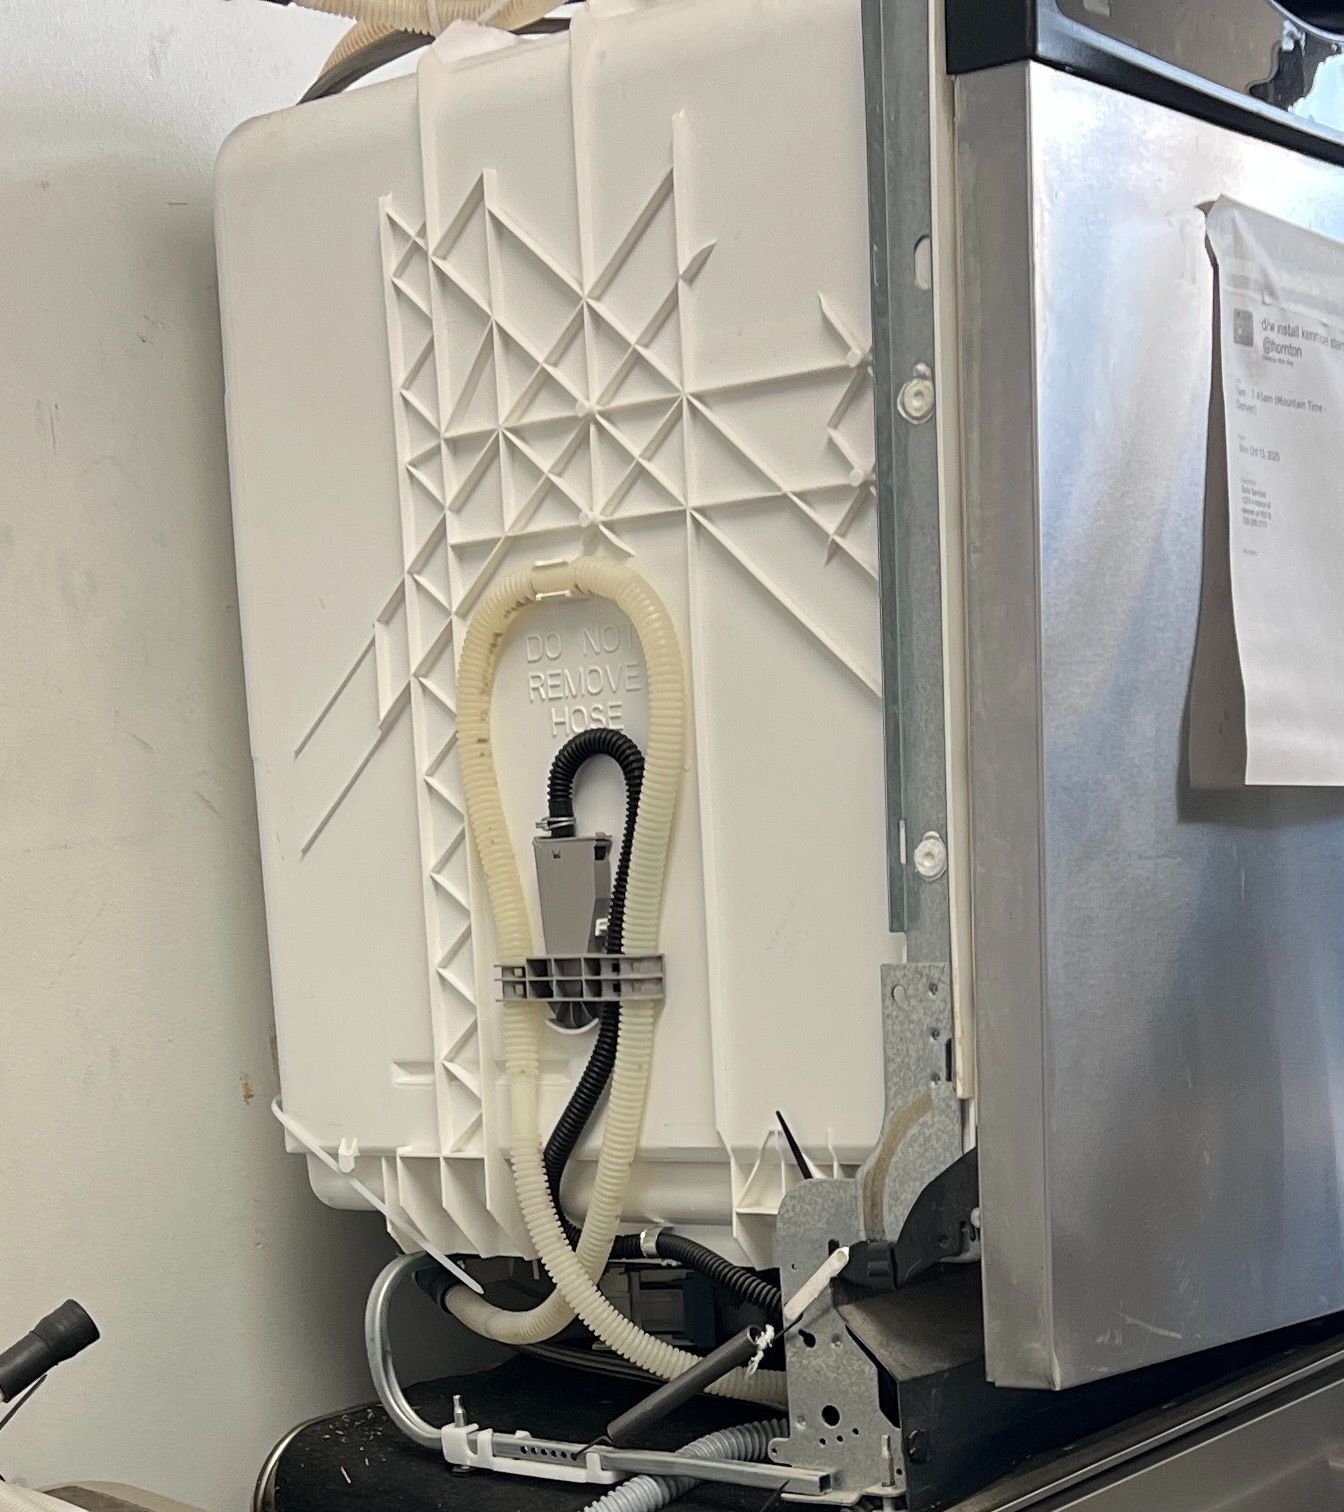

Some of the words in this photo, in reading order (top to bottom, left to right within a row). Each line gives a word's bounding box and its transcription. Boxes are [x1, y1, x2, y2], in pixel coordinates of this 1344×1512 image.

[526, 632, 563, 664] DO
[582, 623, 635, 657] NOT
[528, 662, 643, 704] REMOVE
[551, 701, 625, 738] HOSE
